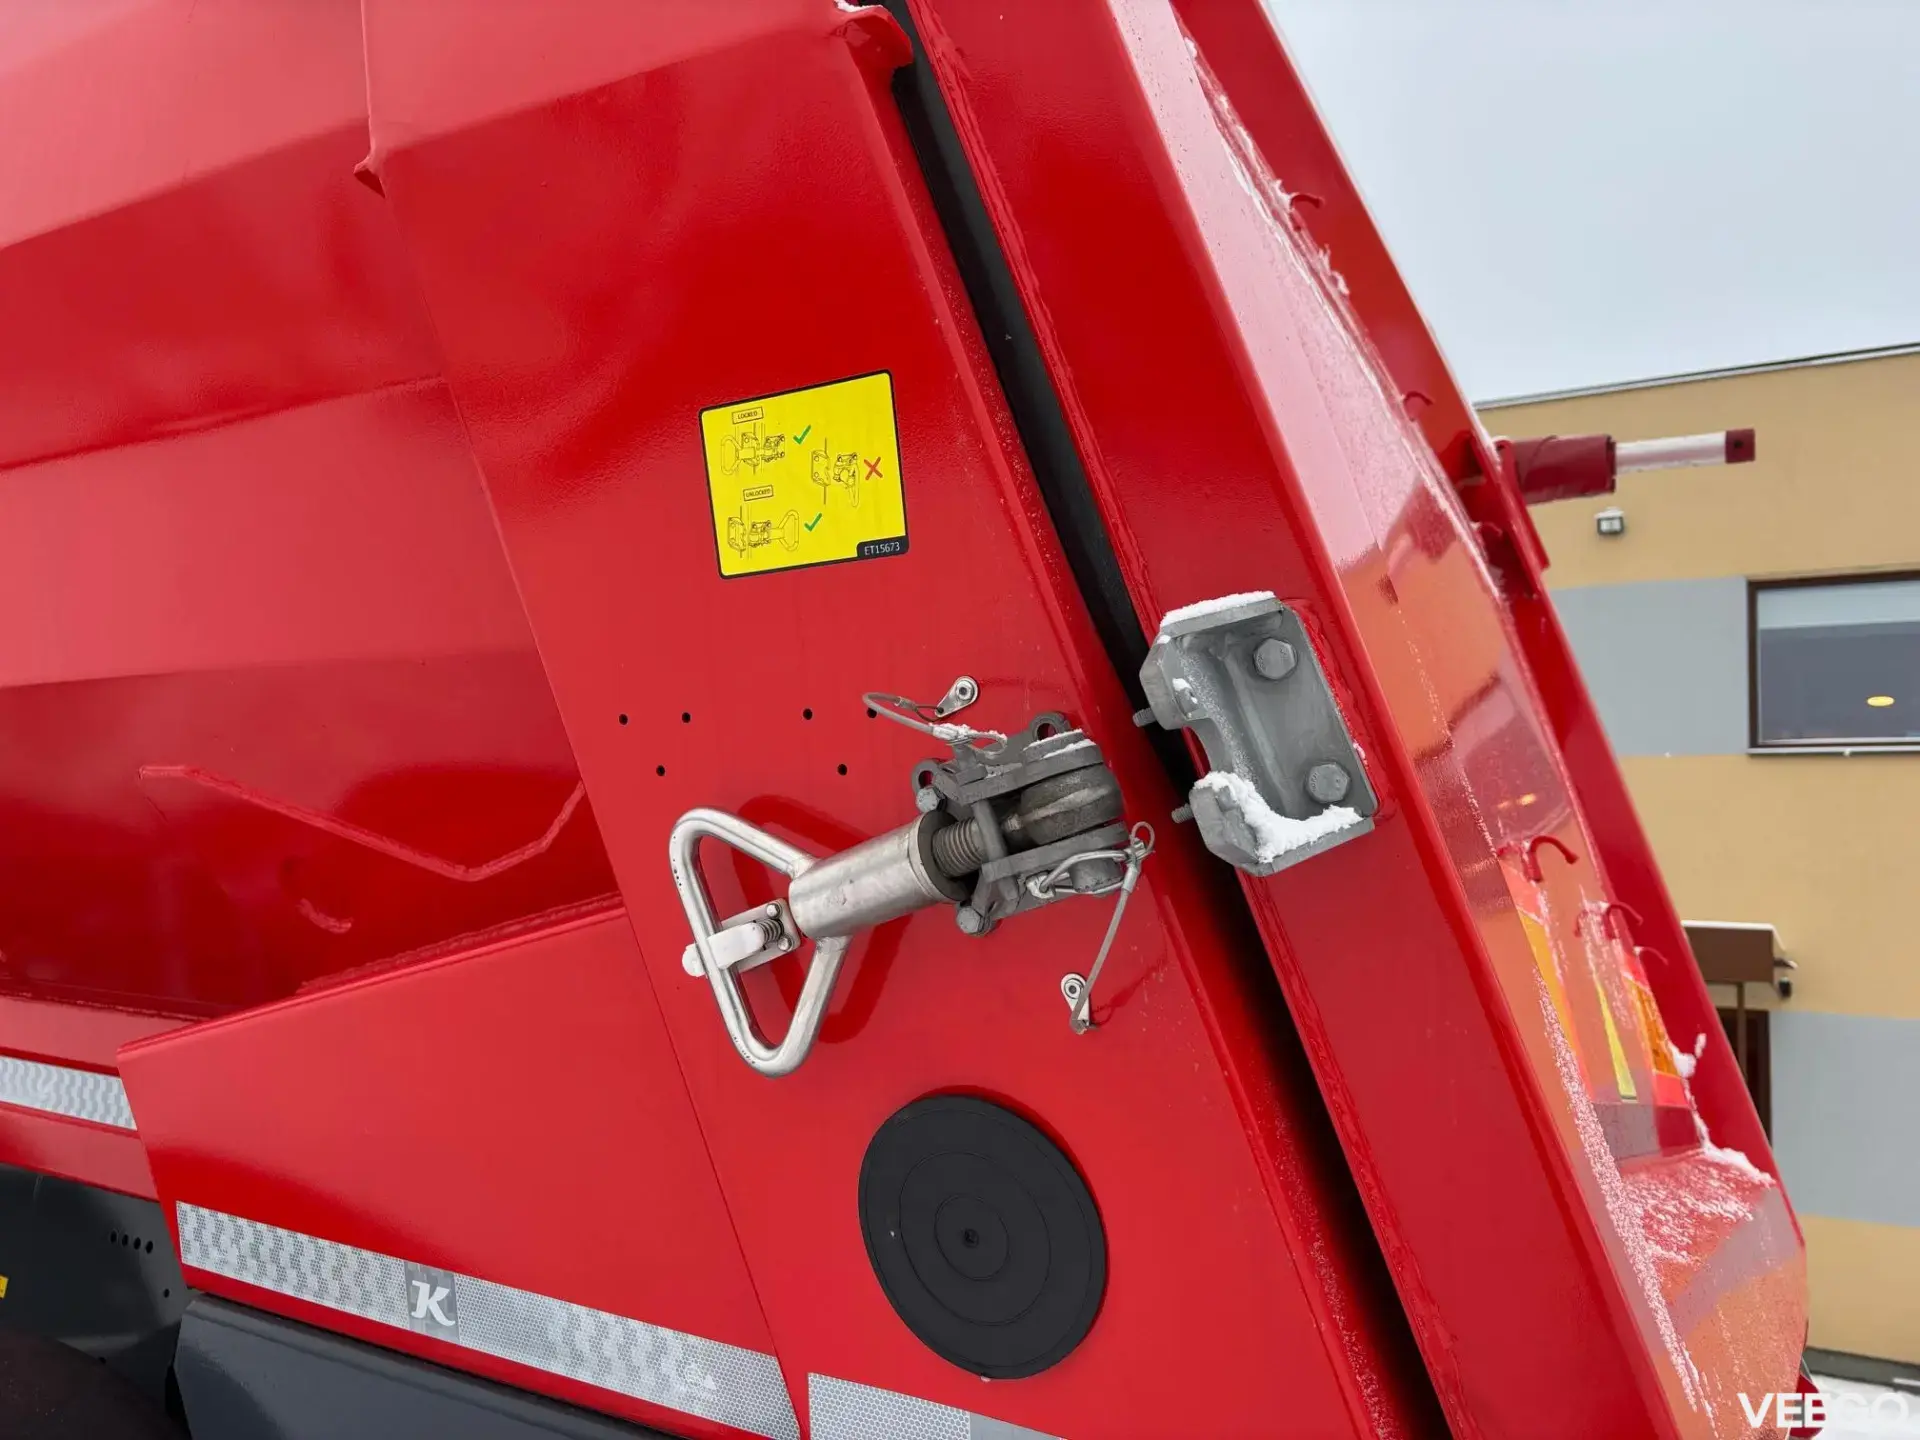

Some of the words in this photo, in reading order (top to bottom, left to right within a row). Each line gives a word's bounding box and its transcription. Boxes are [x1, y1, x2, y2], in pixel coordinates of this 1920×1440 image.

[737, 410, 758, 420] LOCKED
[745, 488, 771, 498] UNLOCKED
[864, 541, 900, 556] ET15673
[410, 1279, 456, 1327] K
